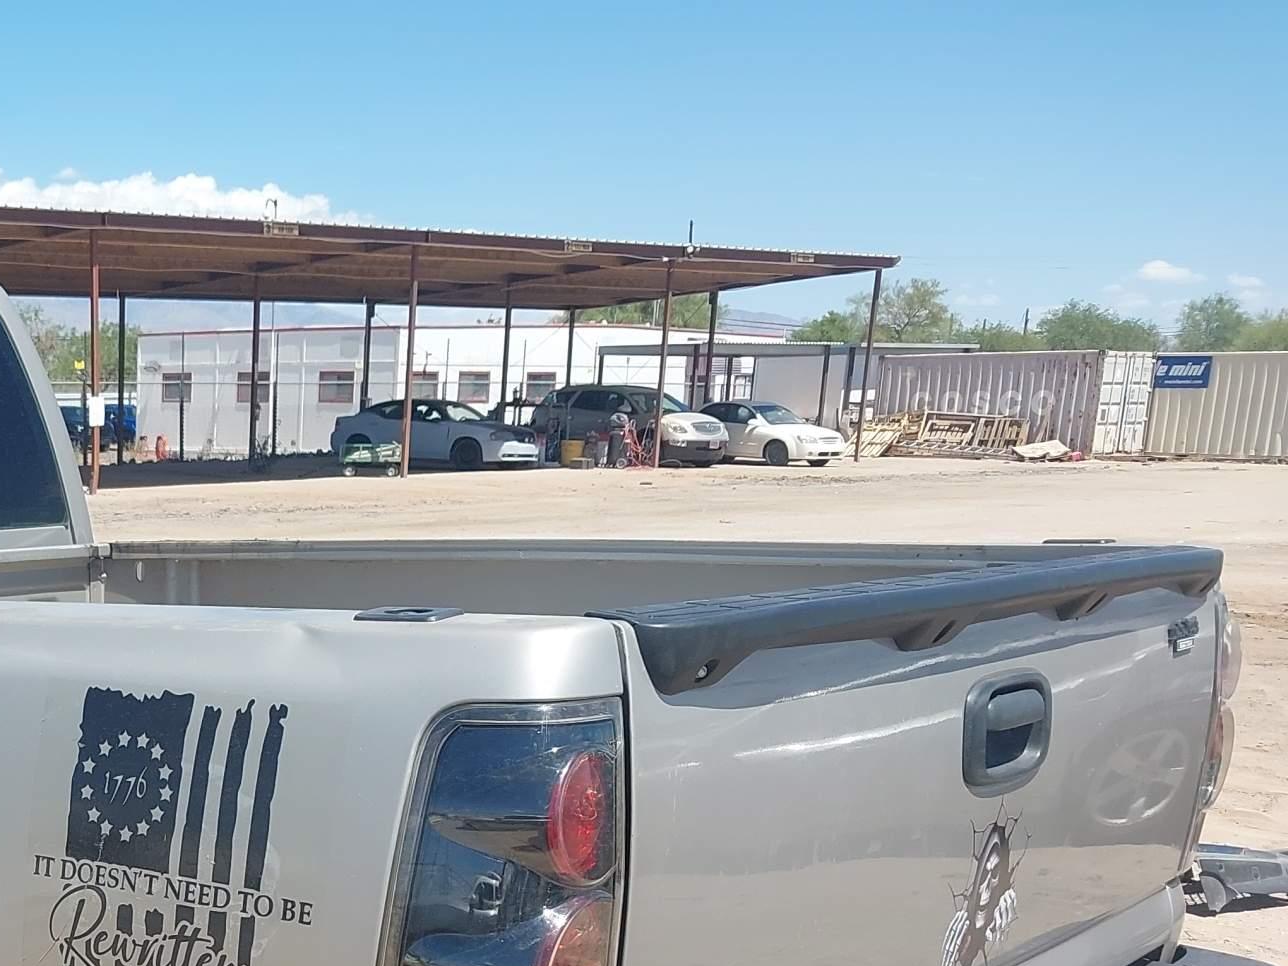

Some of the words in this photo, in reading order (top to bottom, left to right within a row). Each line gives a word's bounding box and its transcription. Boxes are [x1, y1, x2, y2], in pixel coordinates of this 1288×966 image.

[1168, 361, 1208, 376] mini
[103, 767, 148, 805] 1776
[33, 855, 55, 877] IT
[60, 859, 159, 896] DOESN'T
[164, 879, 231, 909] NEED
[238, 890, 274, 918] TO
[281, 898, 313, 926] BE
